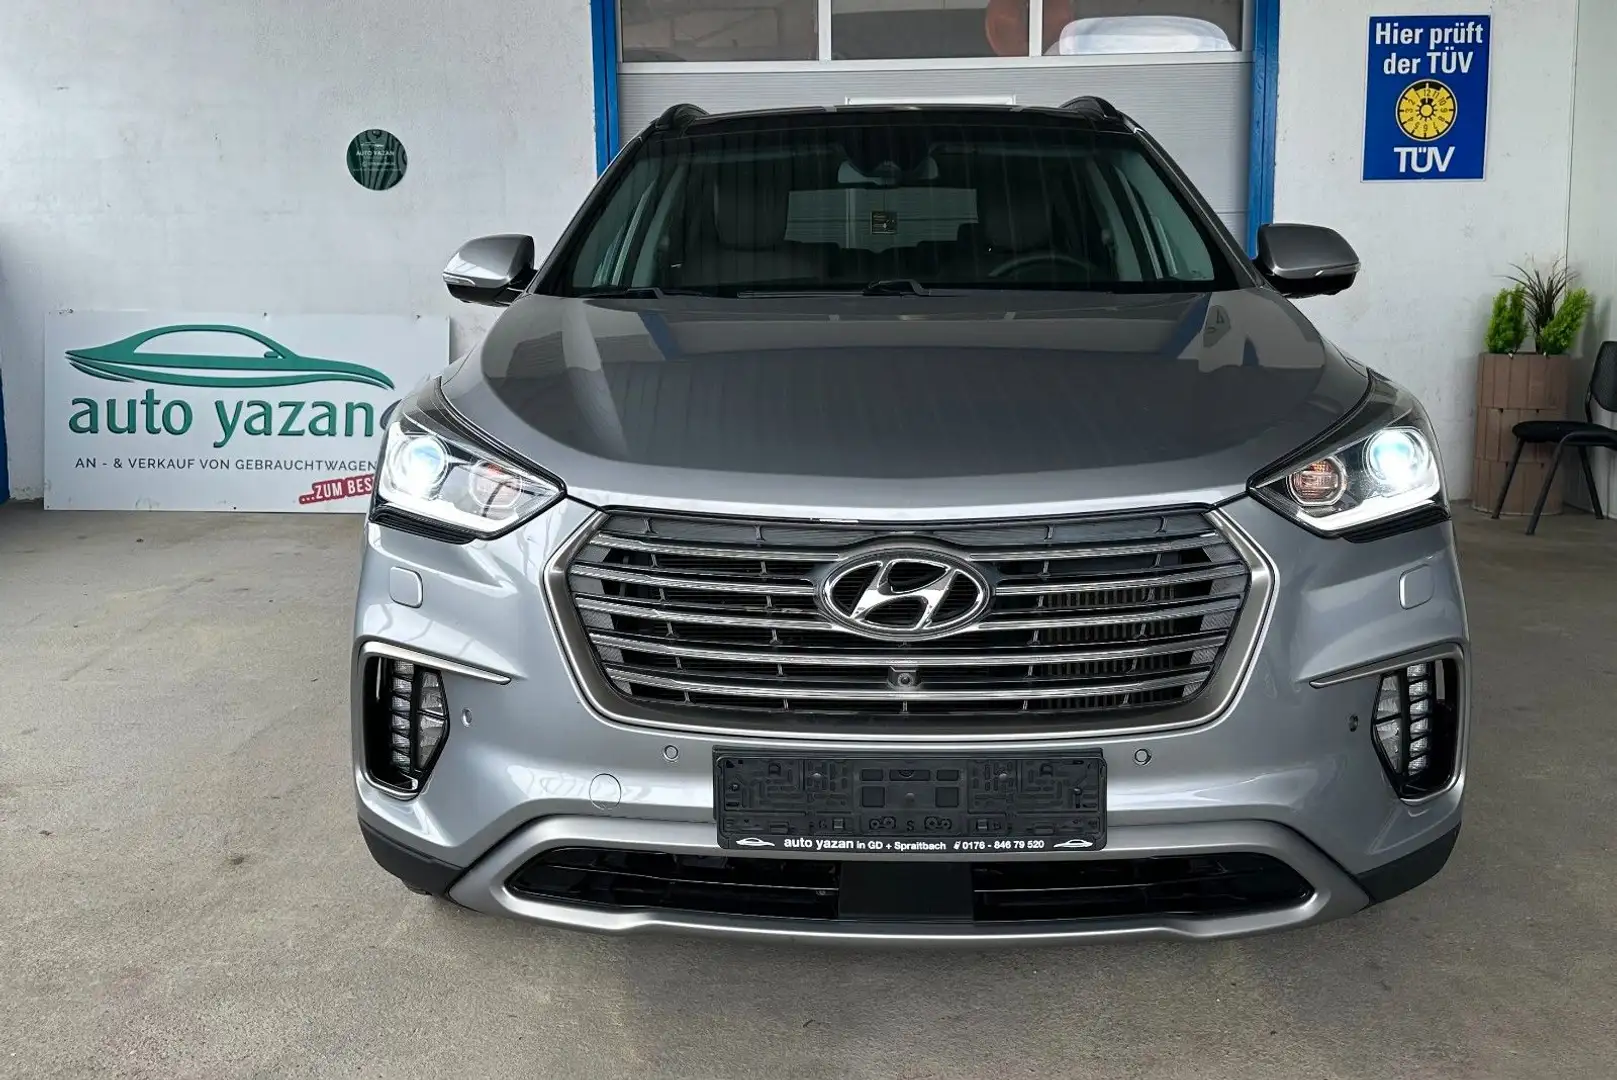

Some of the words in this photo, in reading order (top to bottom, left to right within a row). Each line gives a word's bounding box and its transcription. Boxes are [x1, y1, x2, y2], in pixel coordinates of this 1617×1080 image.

[1375, 22, 1423, 45] Hier
[1429, 22, 1483, 50] prüft
[1383, 53, 1421, 75] der
[1427, 46, 1473, 74] TÜV
[1423, 89, 1431, 97] 12
[1393, 147, 1456, 173] TÜV
[68, 388, 193, 436] auto
[213, 400, 374, 448] yazan
[75, 458, 97, 468] AN
[113, 458, 123, 469] &
[128, 458, 196, 470] VERKAUF
[200, 459, 230, 470] VON
[235, 459, 377, 471] GEBRAUCHTWAGEN
[783, 838, 813, 848] auto
[815, 839, 854, 851] yazan
[856, 841, 866, 849] in
[867, 841, 884, 850] GD
[894, 841, 946, 851] Spraitbach
[993, 840, 1011, 849] 846
[1013, 840, 1025, 849] 79
[1027, 840, 1045, 849] 520
